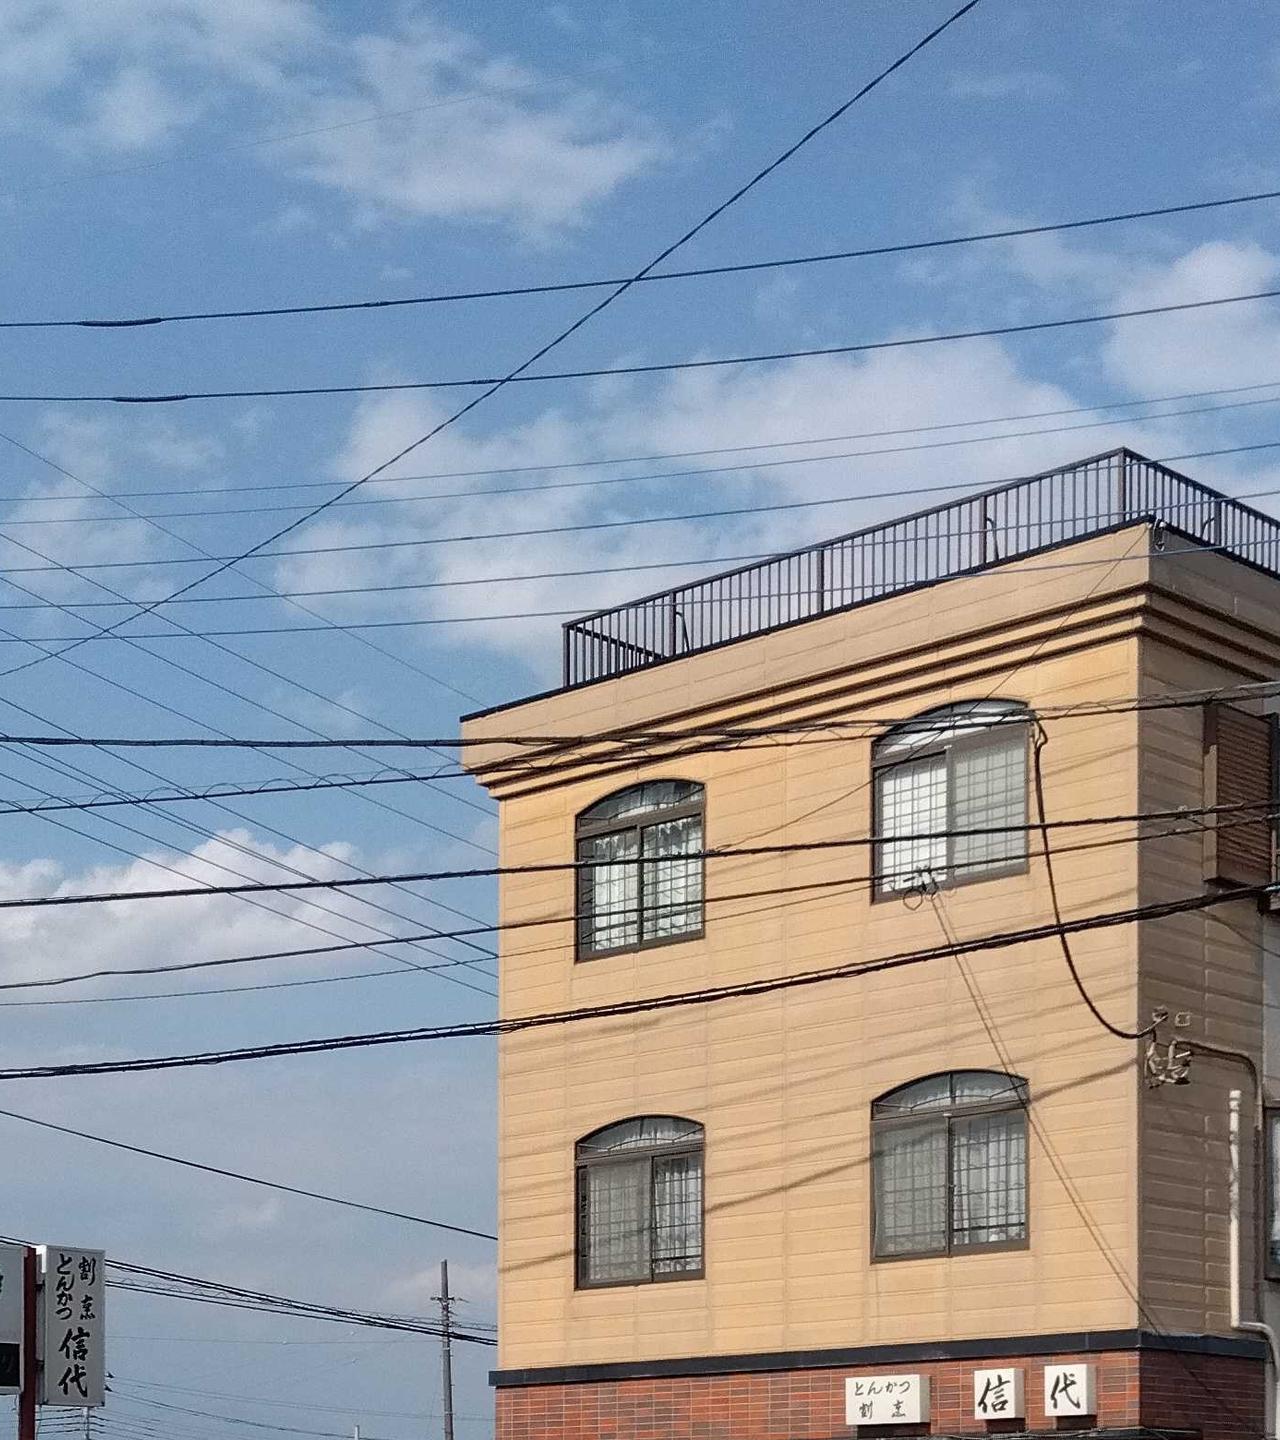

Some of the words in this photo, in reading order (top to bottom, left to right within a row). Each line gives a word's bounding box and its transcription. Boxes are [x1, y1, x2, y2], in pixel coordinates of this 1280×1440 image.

[55, 1253, 75, 1320] とんかつ
[58, 1326, 90, 1398] 信代
[854, 1381, 911, 1396] とんかつ
